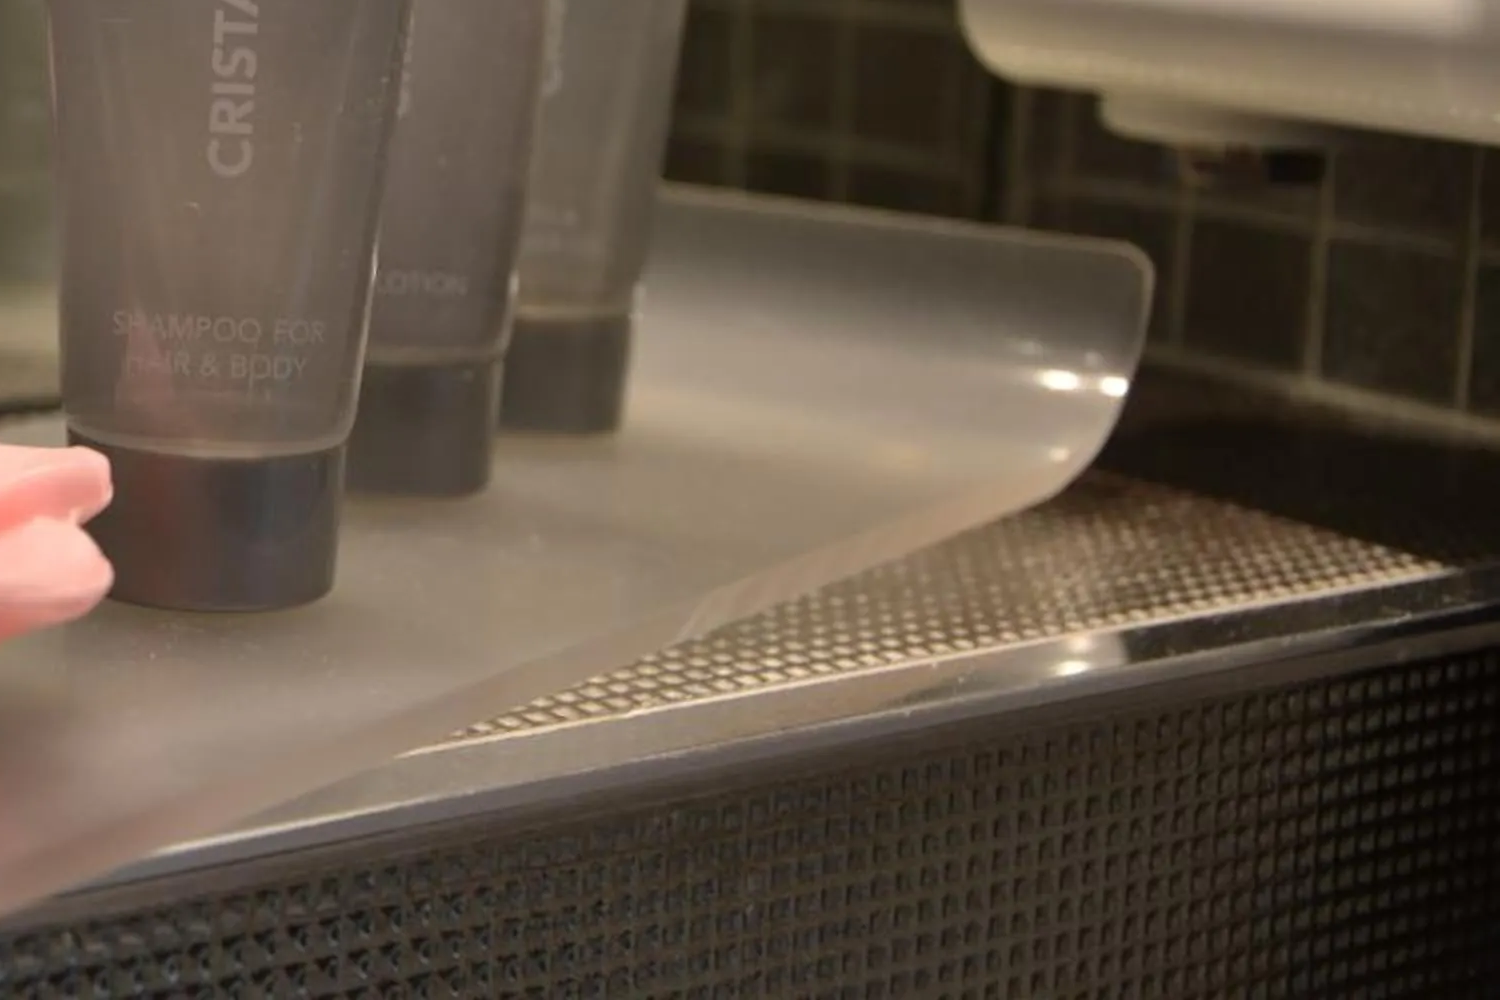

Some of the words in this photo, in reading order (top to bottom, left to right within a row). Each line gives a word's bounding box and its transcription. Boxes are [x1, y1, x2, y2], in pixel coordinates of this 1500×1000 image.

[112, 311, 262, 343] SHAMPOO
[273, 317, 326, 345] FOR
[199, 353, 221, 377] &
[230, 353, 308, 379] BODY
